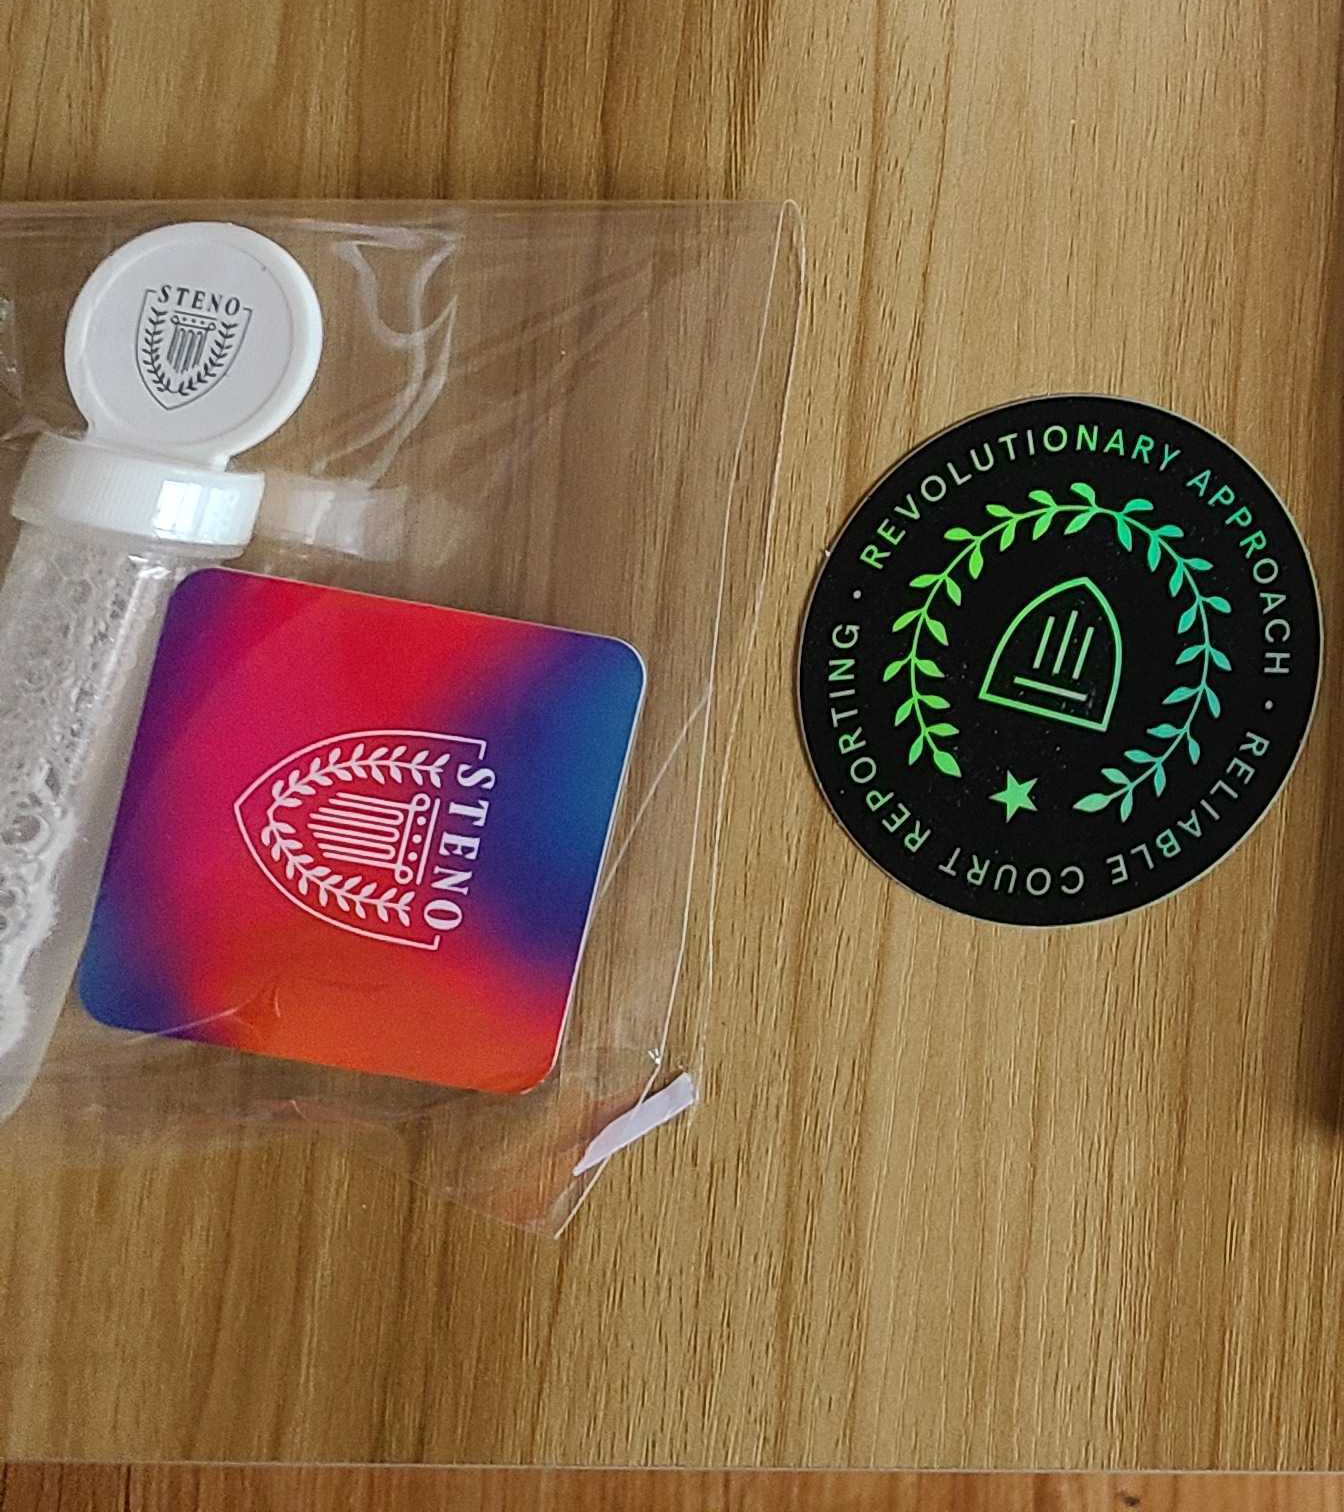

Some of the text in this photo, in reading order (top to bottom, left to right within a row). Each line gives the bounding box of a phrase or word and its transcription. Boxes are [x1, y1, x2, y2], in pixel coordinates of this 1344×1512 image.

[158, 284, 240, 316] STENO
[827, 423, 1291, 896] REVOLUTIONARY APPROACH RELIABLE COURT REPORTING
[423, 763, 496, 930] STENO
